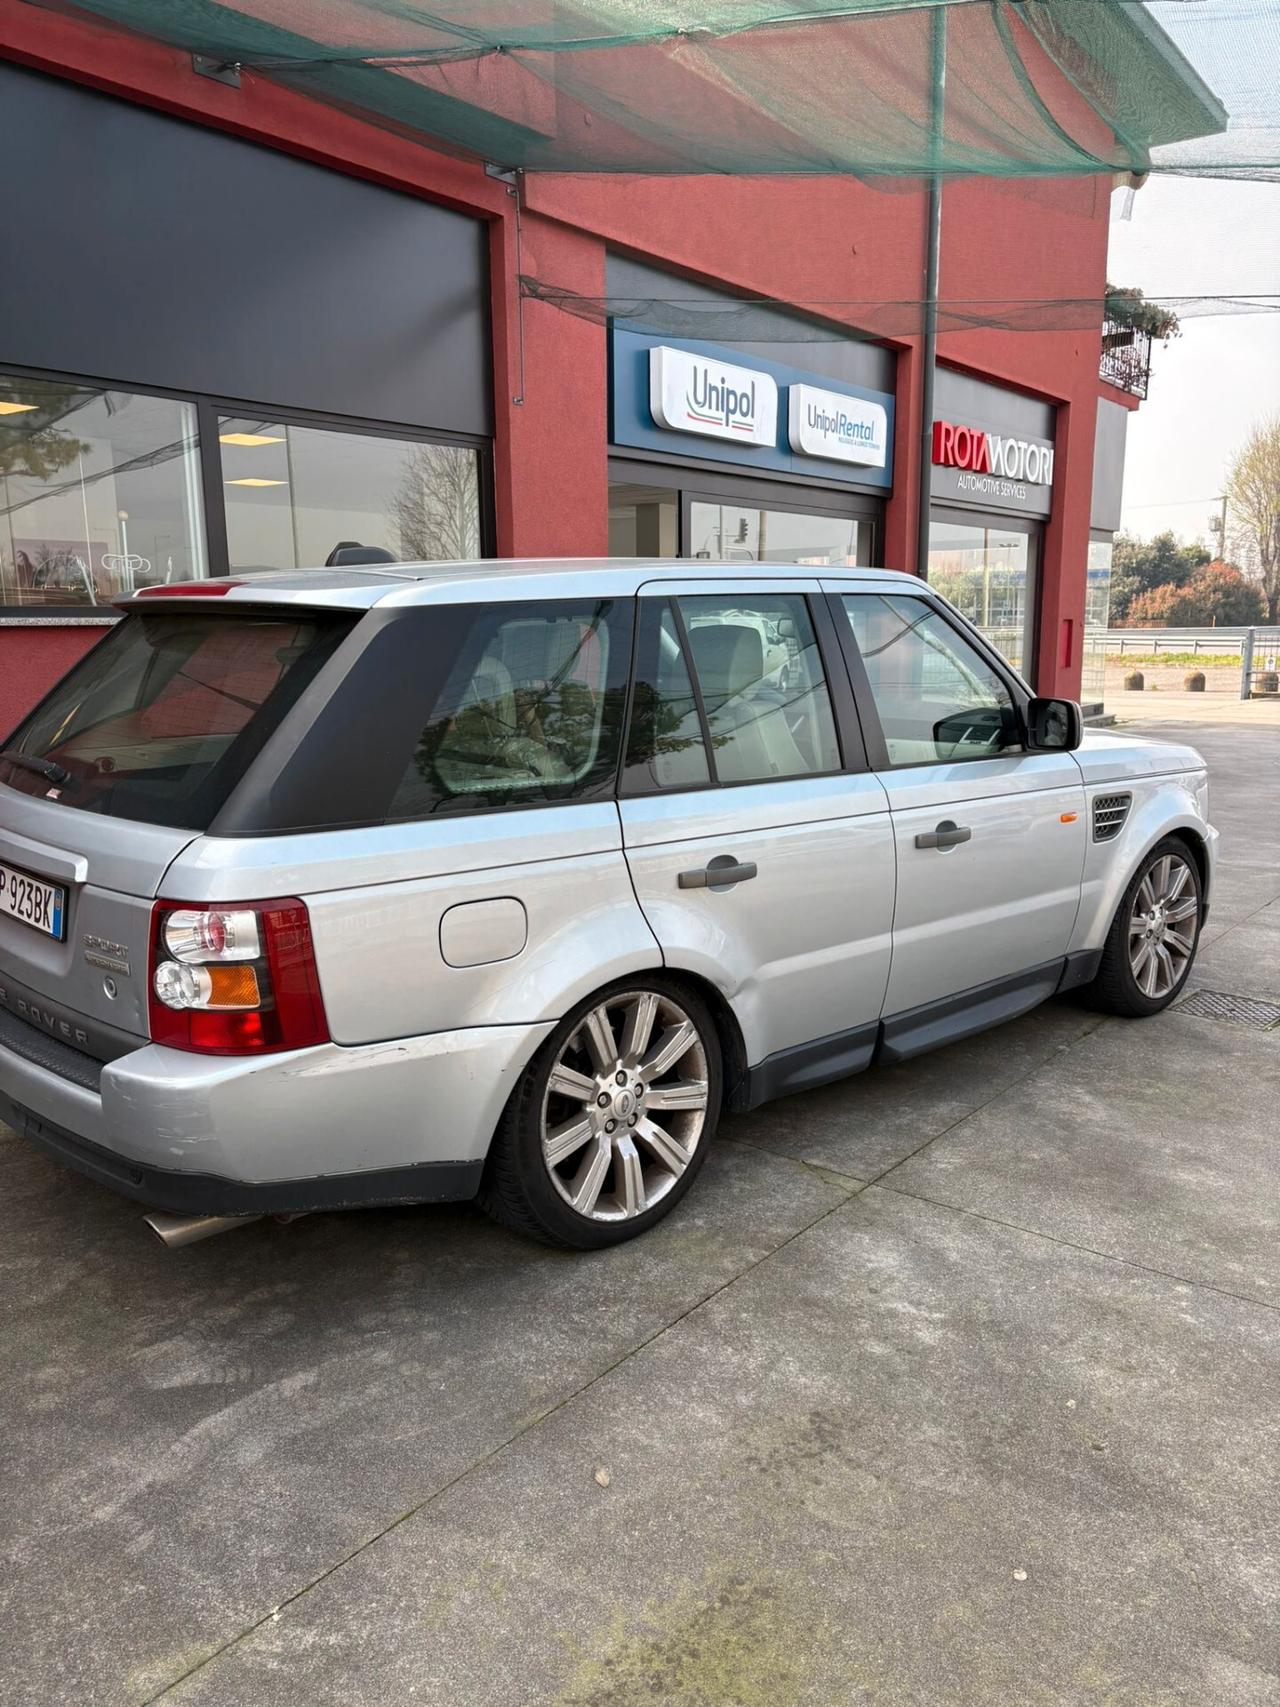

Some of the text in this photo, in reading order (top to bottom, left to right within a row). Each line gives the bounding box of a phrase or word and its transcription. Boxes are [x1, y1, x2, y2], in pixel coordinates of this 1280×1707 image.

[693, 365, 755, 427] Unipol
[957, 474, 1026, 499] AUTOMOTIVE SERVICES
[10, 875, 52, 929] 923BK
[17, 999, 89, 1044] ROVER
